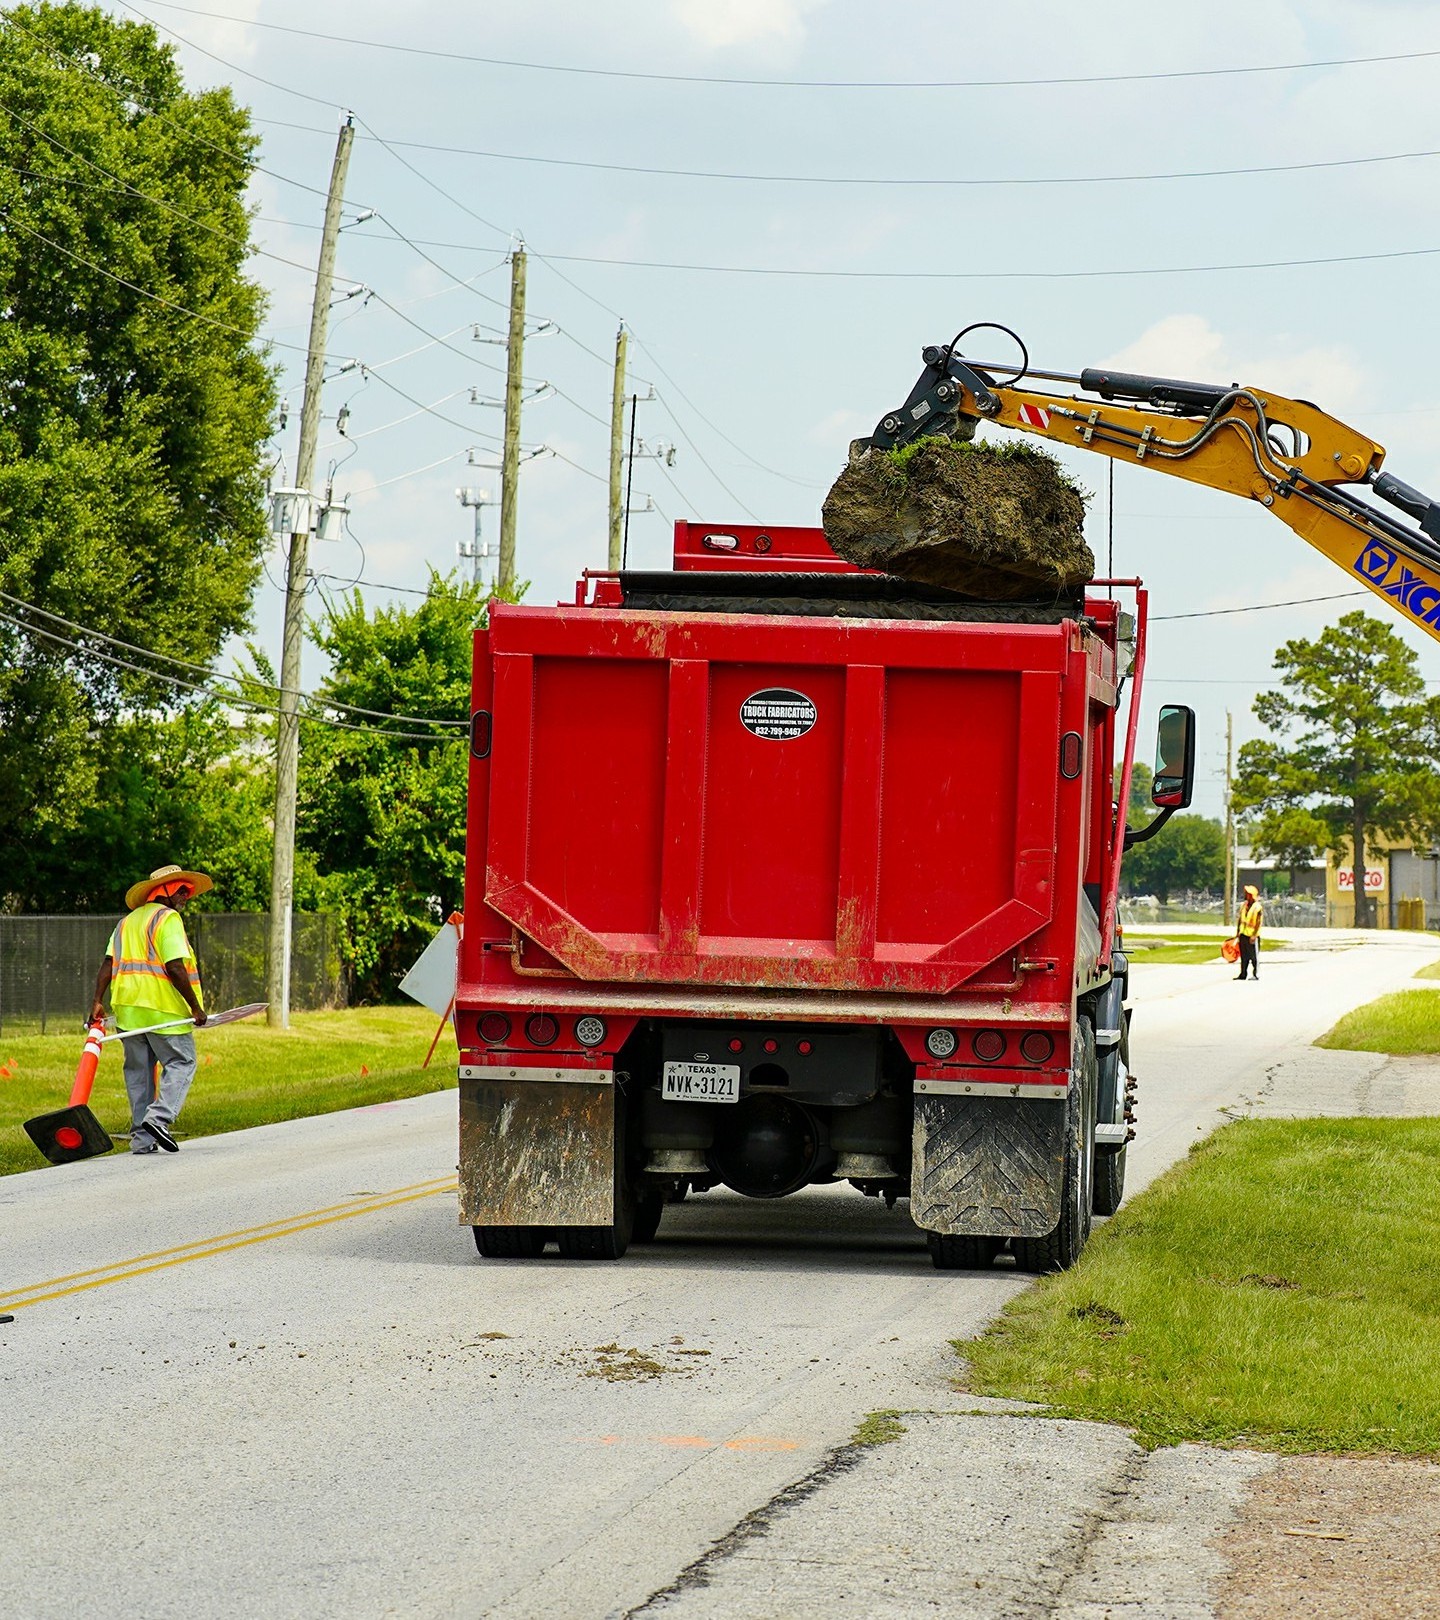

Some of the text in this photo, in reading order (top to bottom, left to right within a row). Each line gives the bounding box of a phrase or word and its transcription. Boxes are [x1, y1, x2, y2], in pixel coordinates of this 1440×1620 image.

[743, 705, 815, 719] TRUCK FABRICATORS
[687, 1065, 717, 1075] TEXAS
